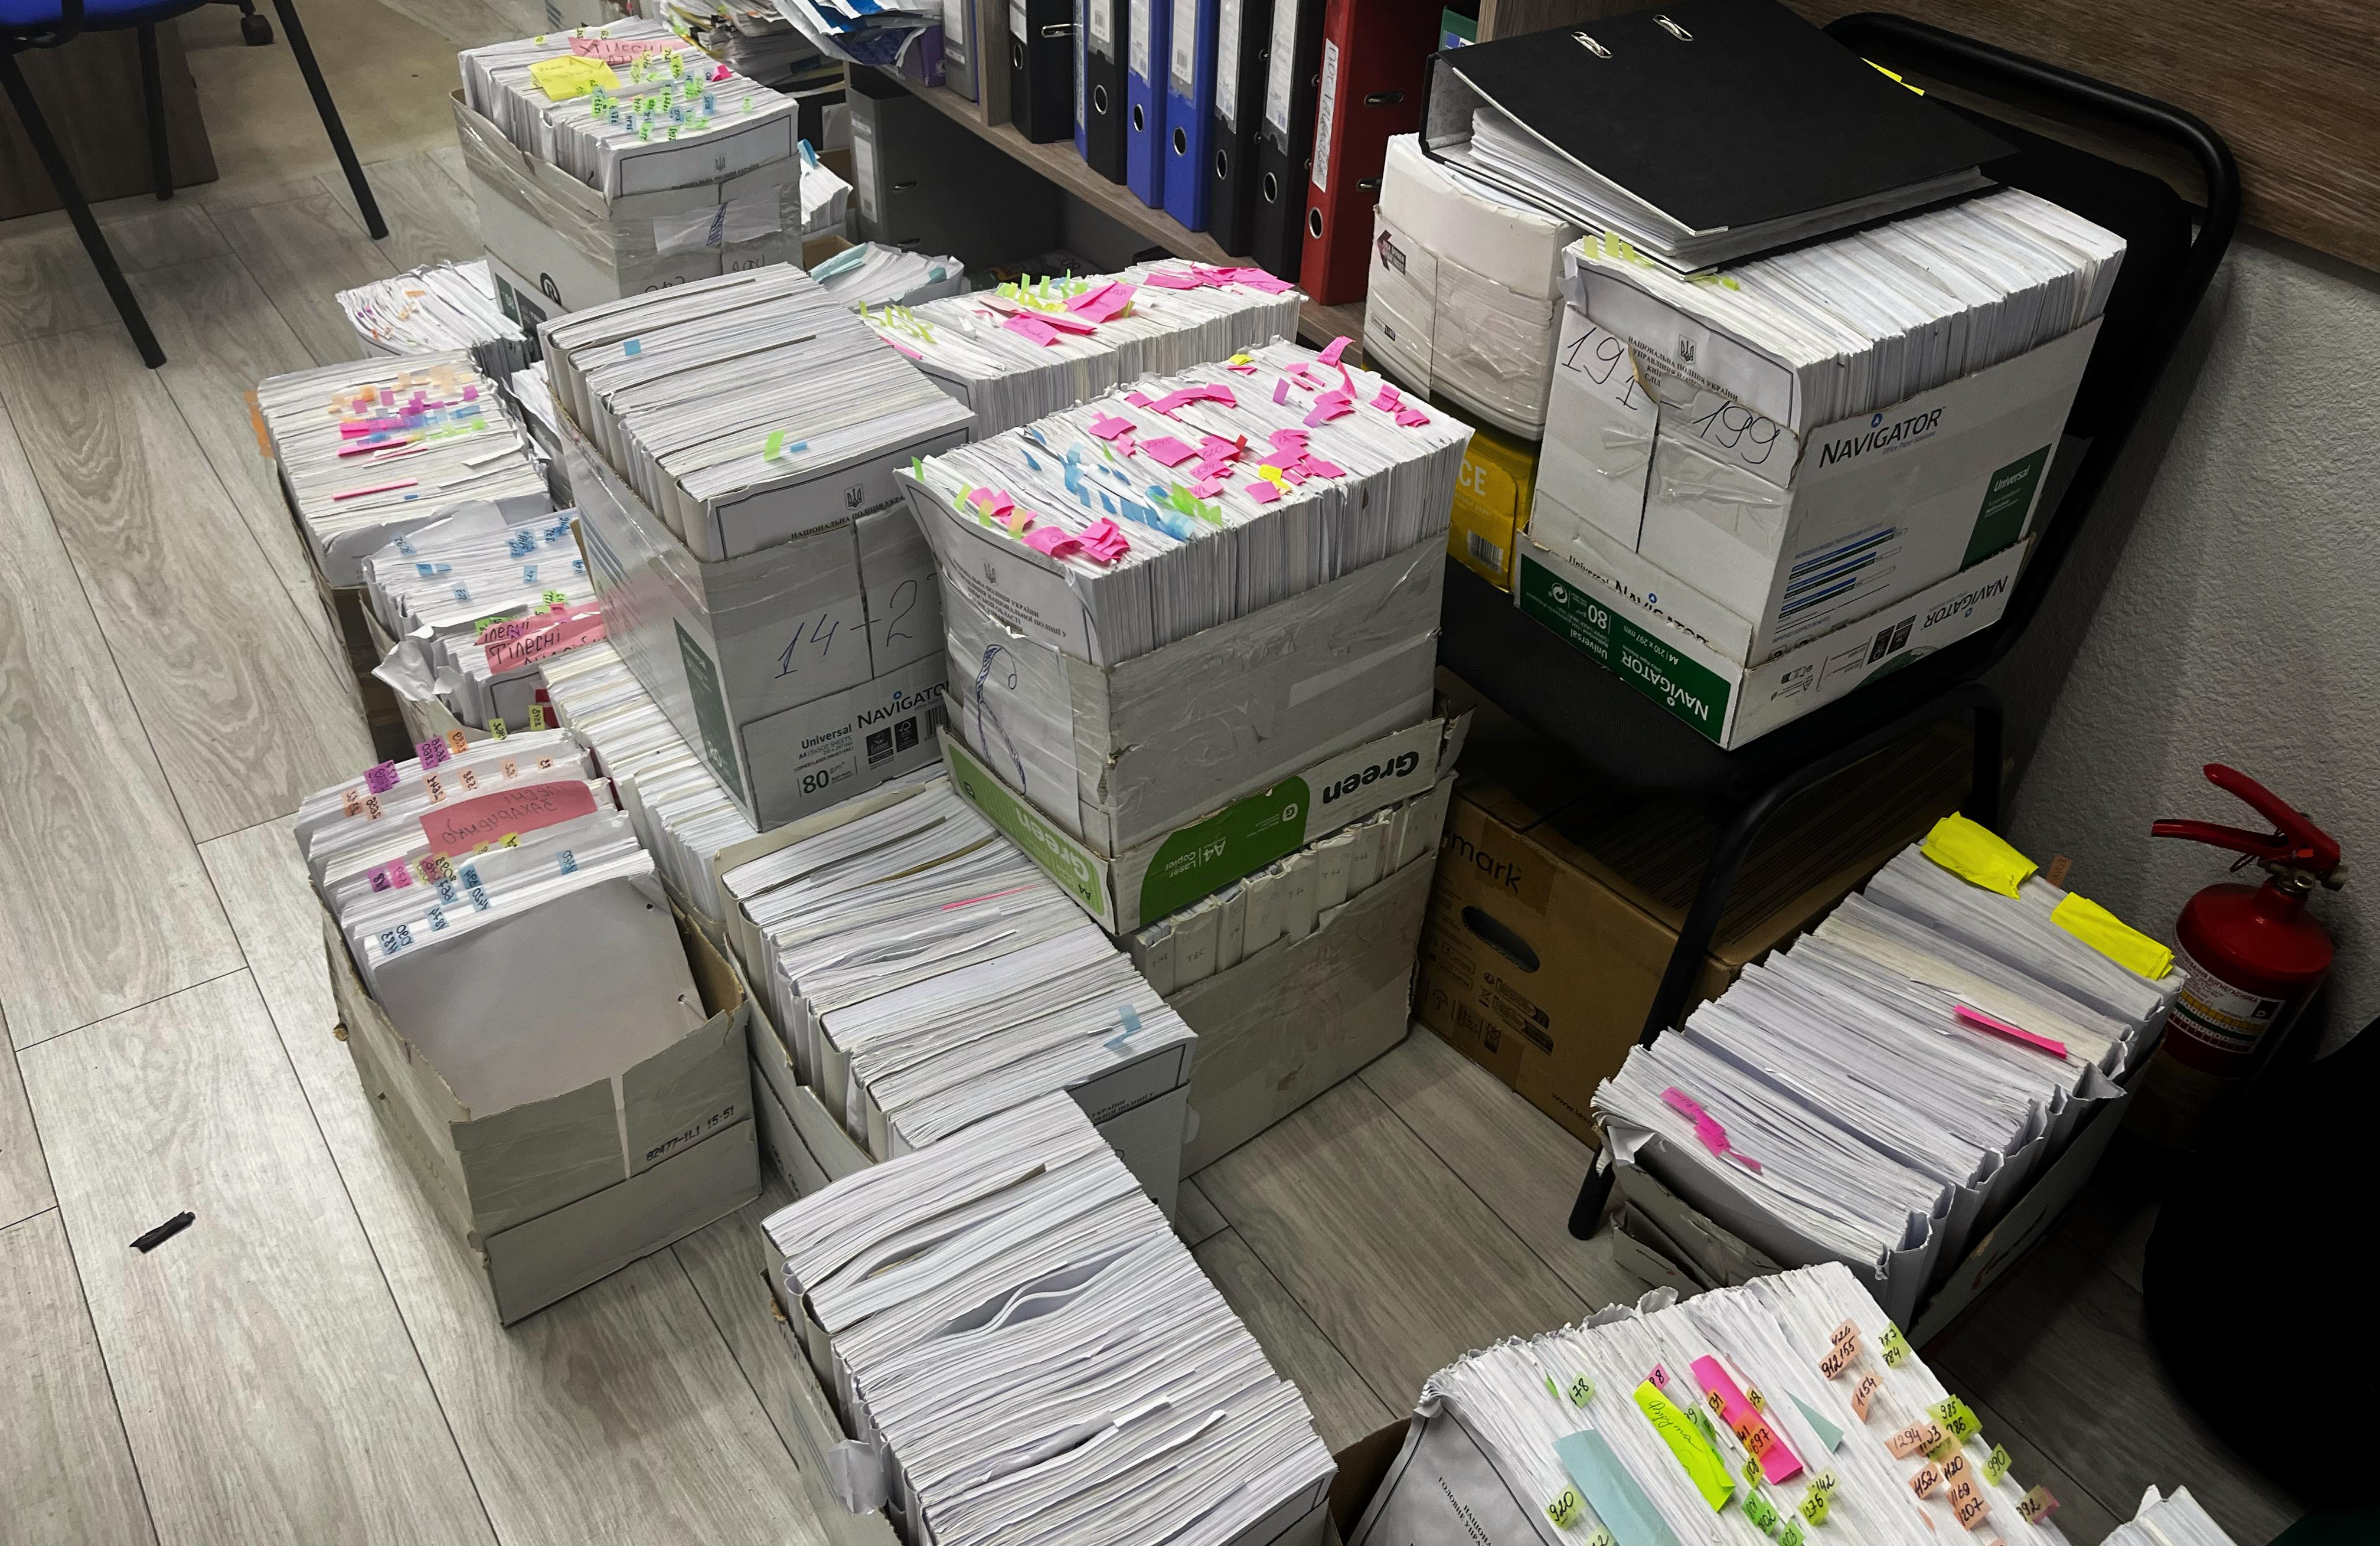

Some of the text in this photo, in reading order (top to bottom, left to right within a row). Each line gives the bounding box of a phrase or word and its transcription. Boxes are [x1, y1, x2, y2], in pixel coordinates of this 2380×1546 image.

[1628, 336, 1675, 368] НАЦІОНАЛЬНА
[1677, 364, 1705, 385] ПОЛІЦІЯ
[1706, 380, 1738, 402] УКРАЇНИ
[1819, 408, 1941, 468] NAVIGATOR
[1993, 465, 2030, 493] Universal
[791, 495, 906, 540] НАЦІОНАЛЬНА ПОЛІЦІЯ УКРА
[988, 593, 1033, 622] НАЦІОНАЛЬНОЇ
[1011, 599, 1039, 618] УКРАЇНИ
[1923, 575, 2009, 629] NAVIGATOR
[1588, 604, 1608, 630] 80
[1570, 629, 1608, 661] Universal
[1635, 634, 1648, 646] 297
[1669, 656, 1679, 665] A4
[1621, 651, 1709, 721] NAVIGATOR
[857, 680, 949, 728] NAVIGATO
[801, 723, 852, 750] Universal
[802, 769, 830, 794] 80
[1322, 751, 1419, 805] Green
[1015, 807, 1089, 883] Green
[1204, 839, 1226, 862] A4
[1165, 851, 1196, 871] Copier
[1169, 858, 1196, 878] Laser
[1078, 884, 1091, 900] A4
[1438, 1476, 1465, 1522] ГОЛОВНЕ
